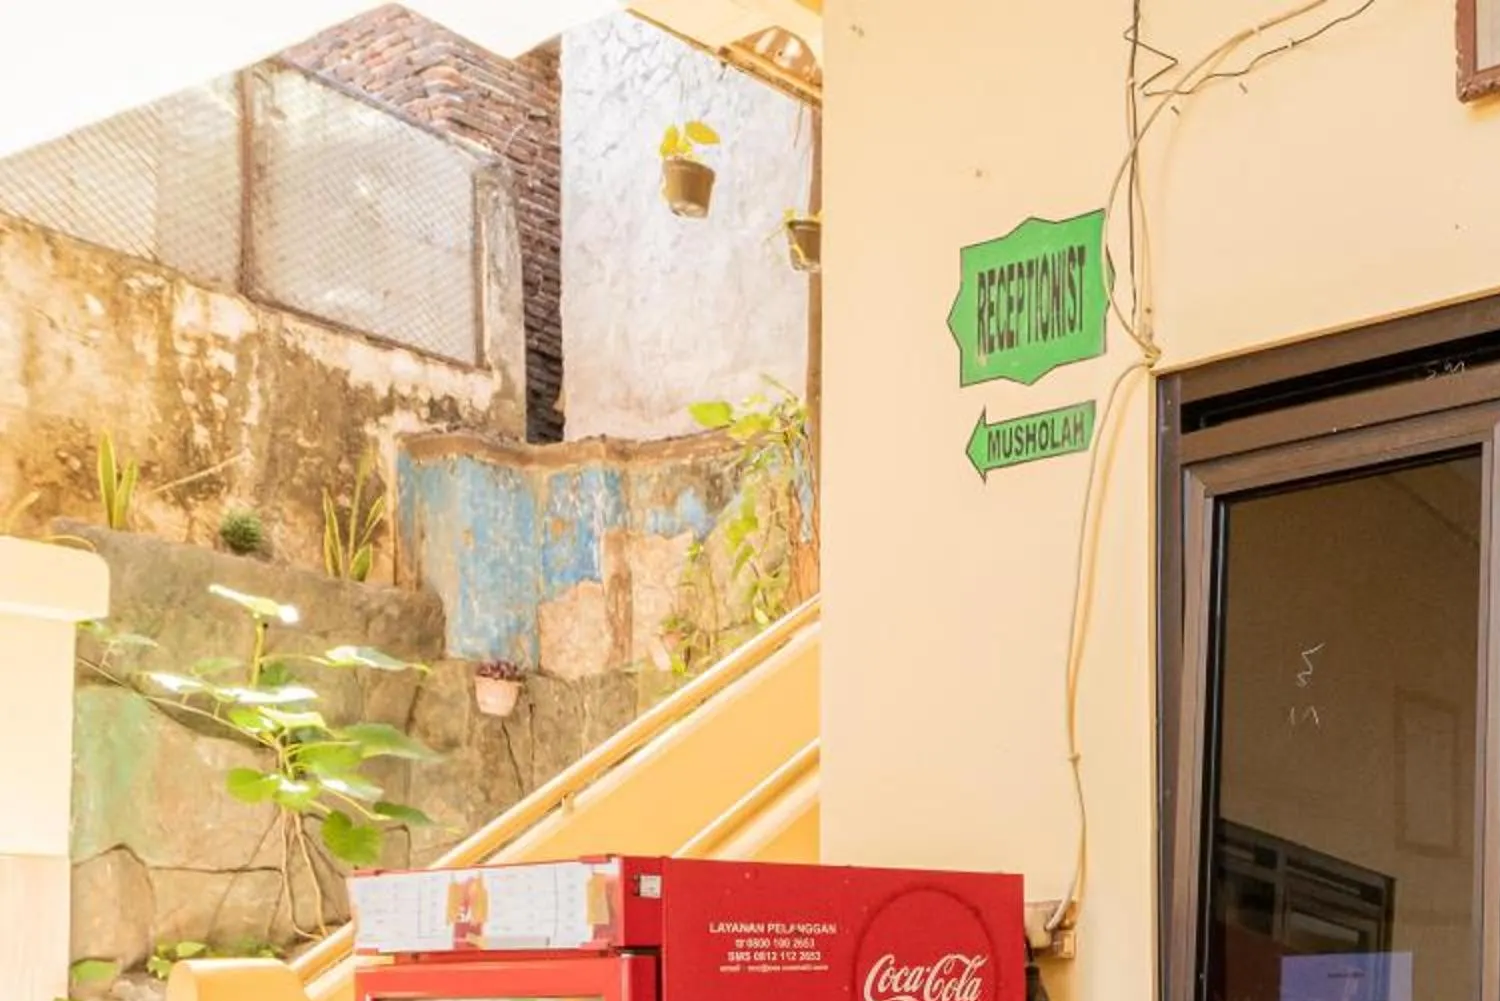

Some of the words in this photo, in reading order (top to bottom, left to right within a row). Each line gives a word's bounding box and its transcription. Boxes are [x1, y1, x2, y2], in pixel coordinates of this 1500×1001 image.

[977, 245, 1086, 356] RECEPTIONIST
[986, 411, 1085, 462] MUSHOLAH
[709, 922, 766, 934] LAYANAN
[767, 923, 837, 935] PELANGGAN
